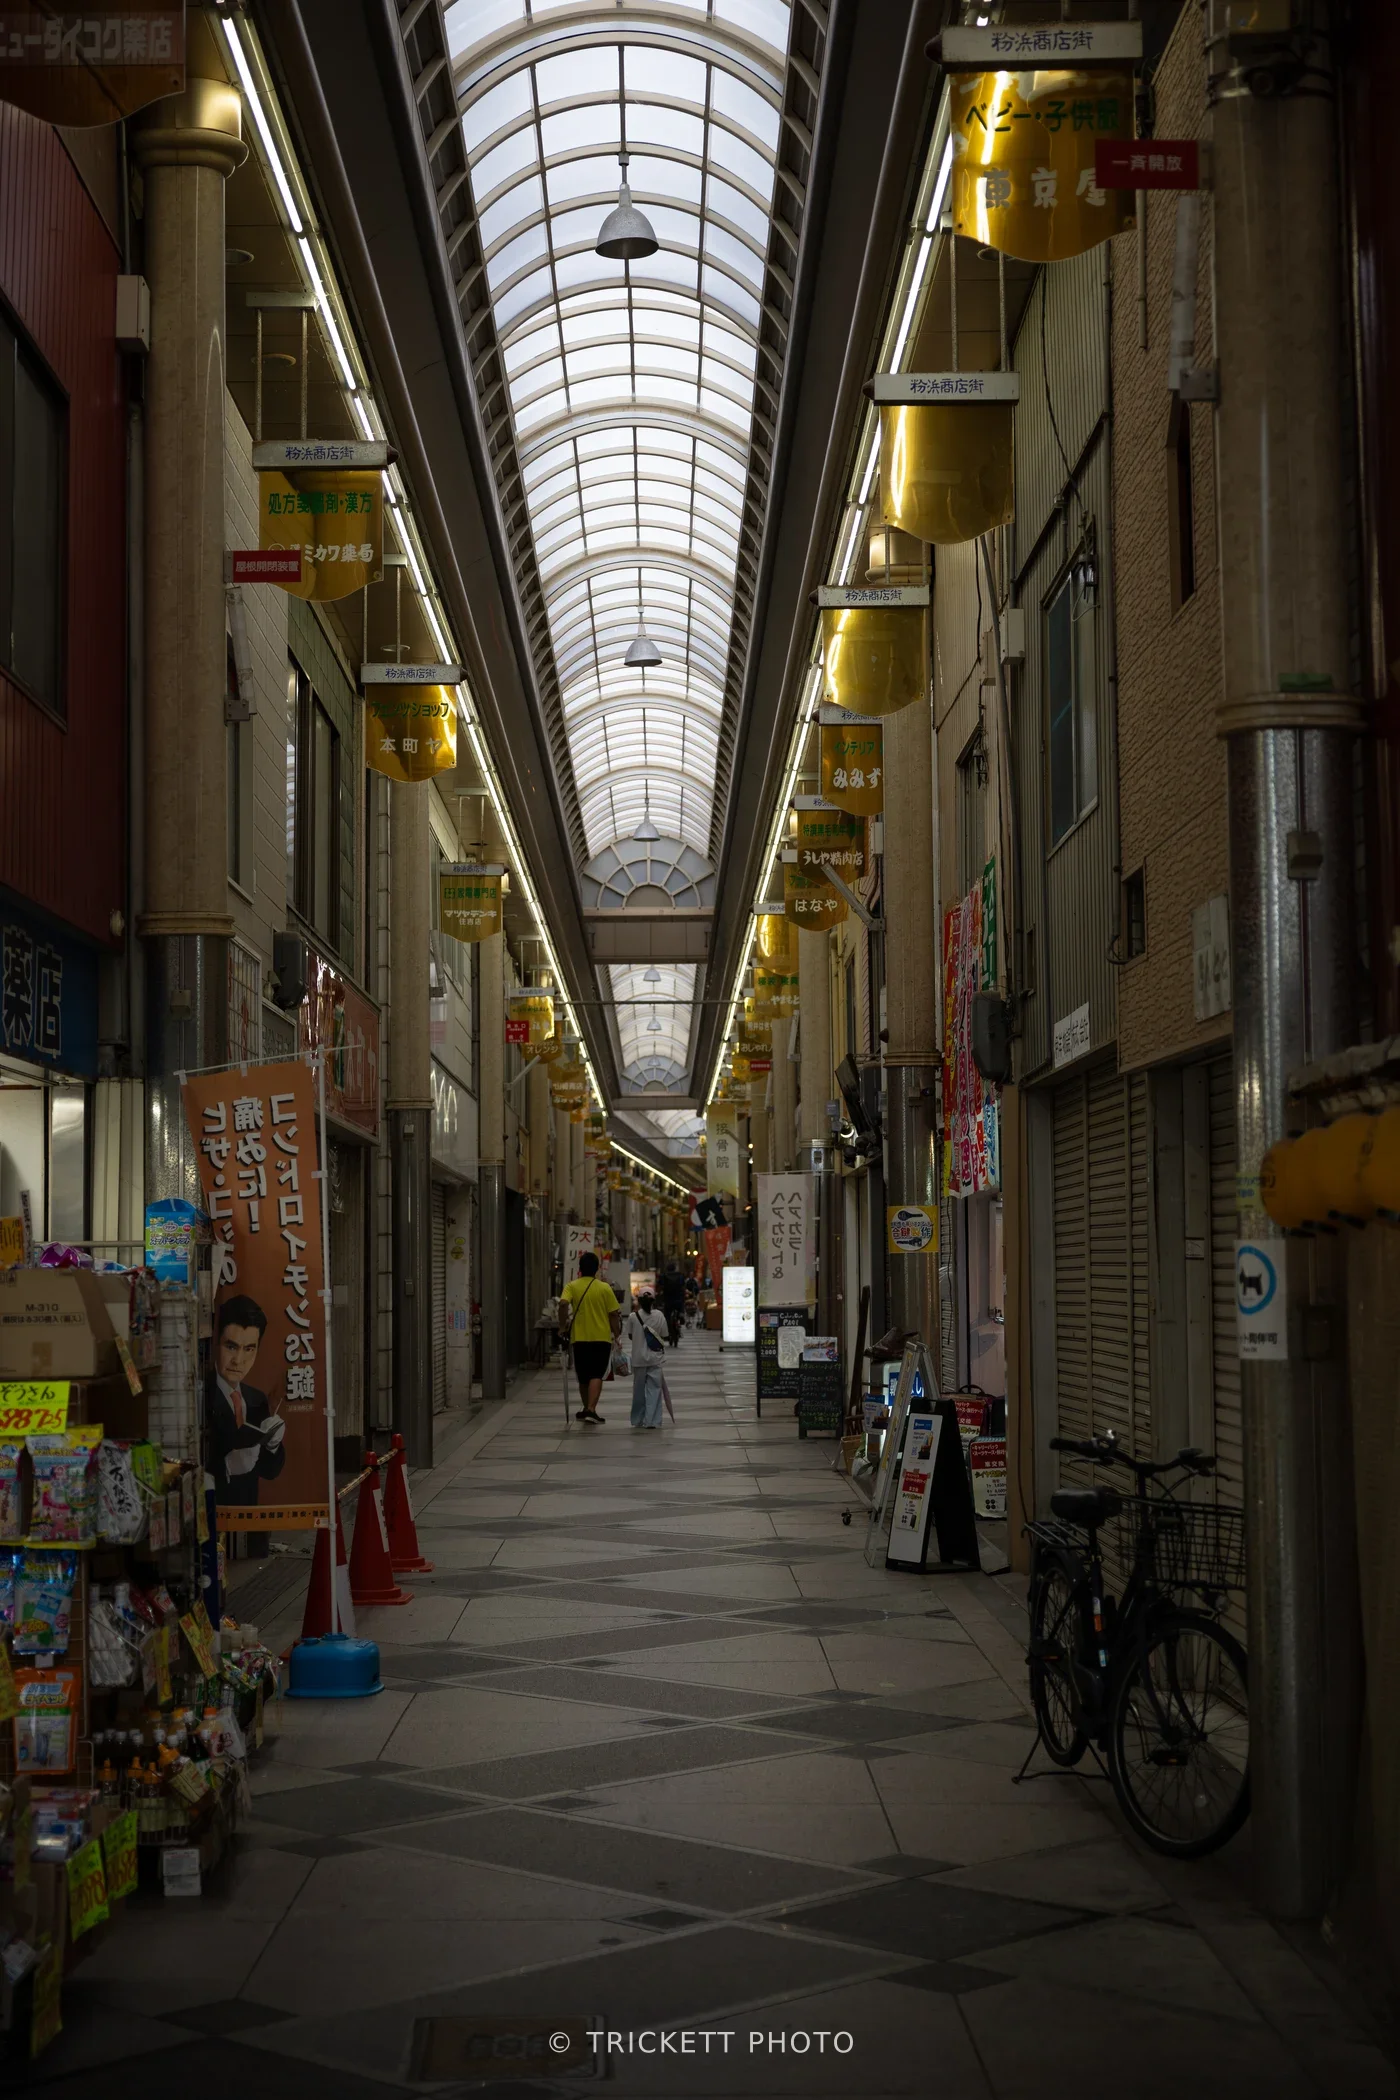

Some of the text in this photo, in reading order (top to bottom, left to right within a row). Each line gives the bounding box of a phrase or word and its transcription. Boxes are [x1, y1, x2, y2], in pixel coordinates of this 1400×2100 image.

[991, 30, 1094, 51] 粉浜商店街
[910, 378, 984, 394] 粉浜商店街
[285, 446, 354, 461] 粉浜商店街
[845, 588, 902, 601] 粉浜商店街
[385, 667, 437, 679] 粉浜商店街
[380, 736, 443, 754] 本町ヤ
[795, 899, 838, 913] はなや
[715, 1122, 730, 1169] 接骨院
[25, 1303, 59, 1312] M-310
